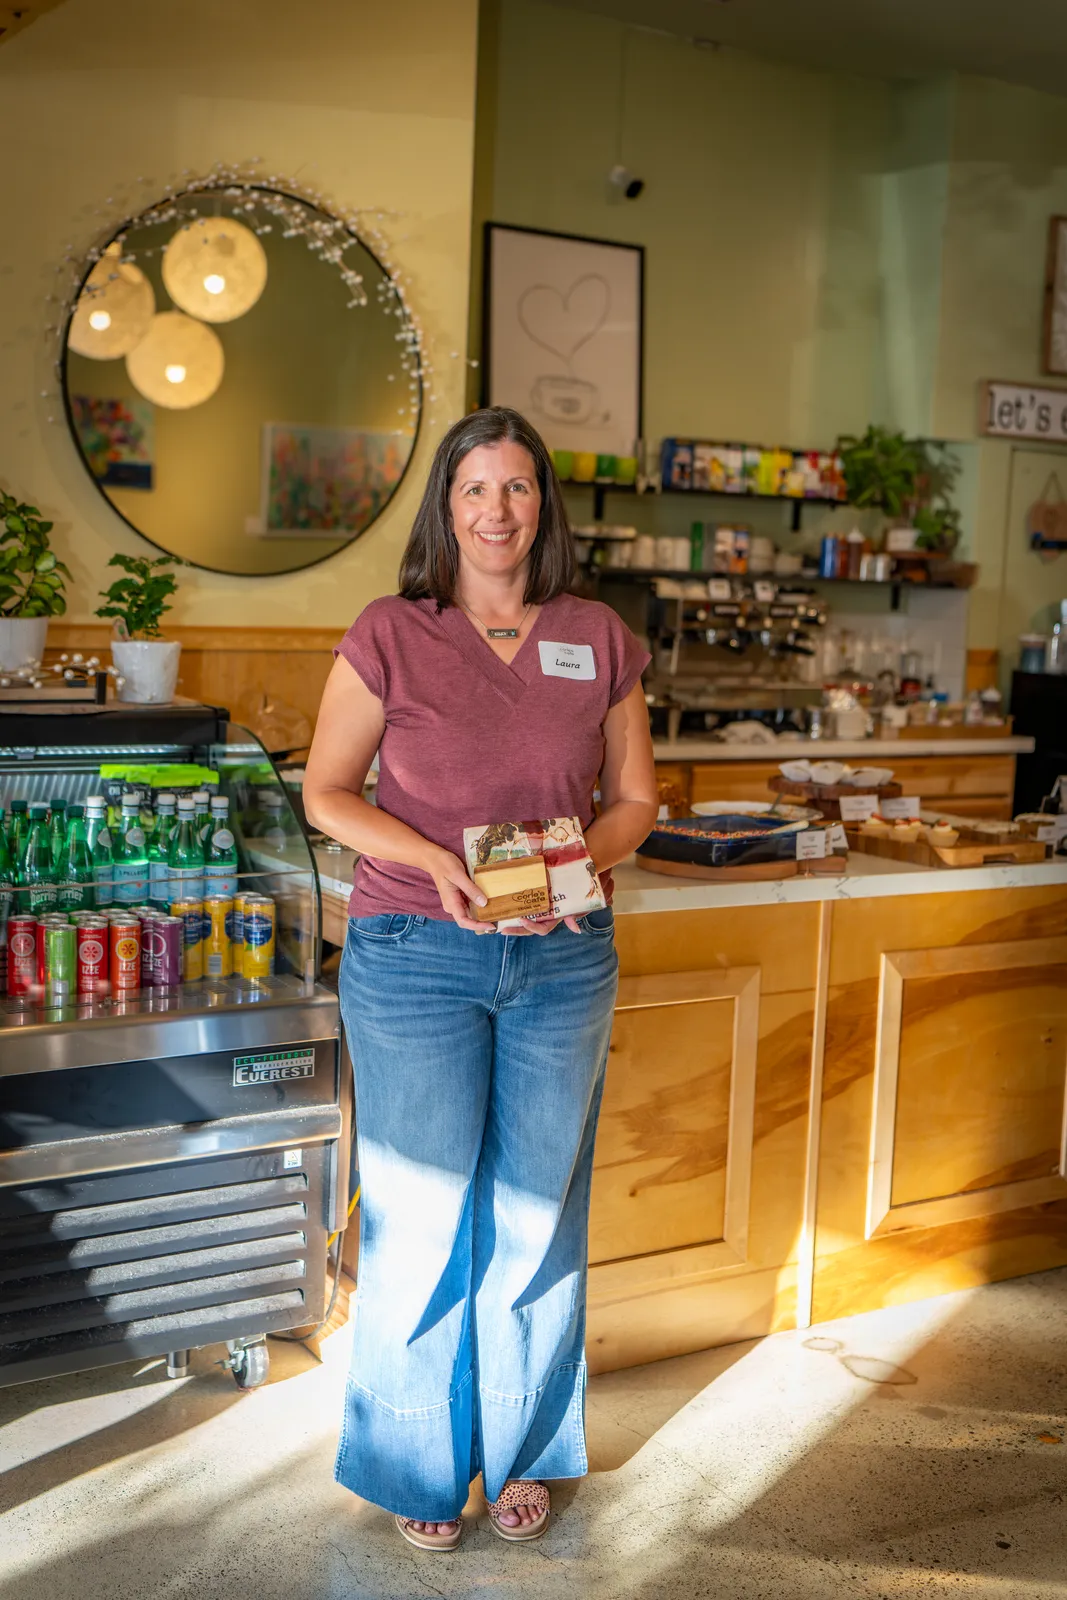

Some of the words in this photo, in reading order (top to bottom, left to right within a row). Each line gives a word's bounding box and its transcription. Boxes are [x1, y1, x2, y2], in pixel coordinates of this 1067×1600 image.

[987, 391, 1052, 433] let's
[555, 658, 581, 669] Laura
[82, 965, 100, 974] IZZE
[120, 961, 137, 971] IZZE
[236, 1050, 312, 1065] ECO-FRIENDLY
[236, 1065, 312, 1084] EVEREST
